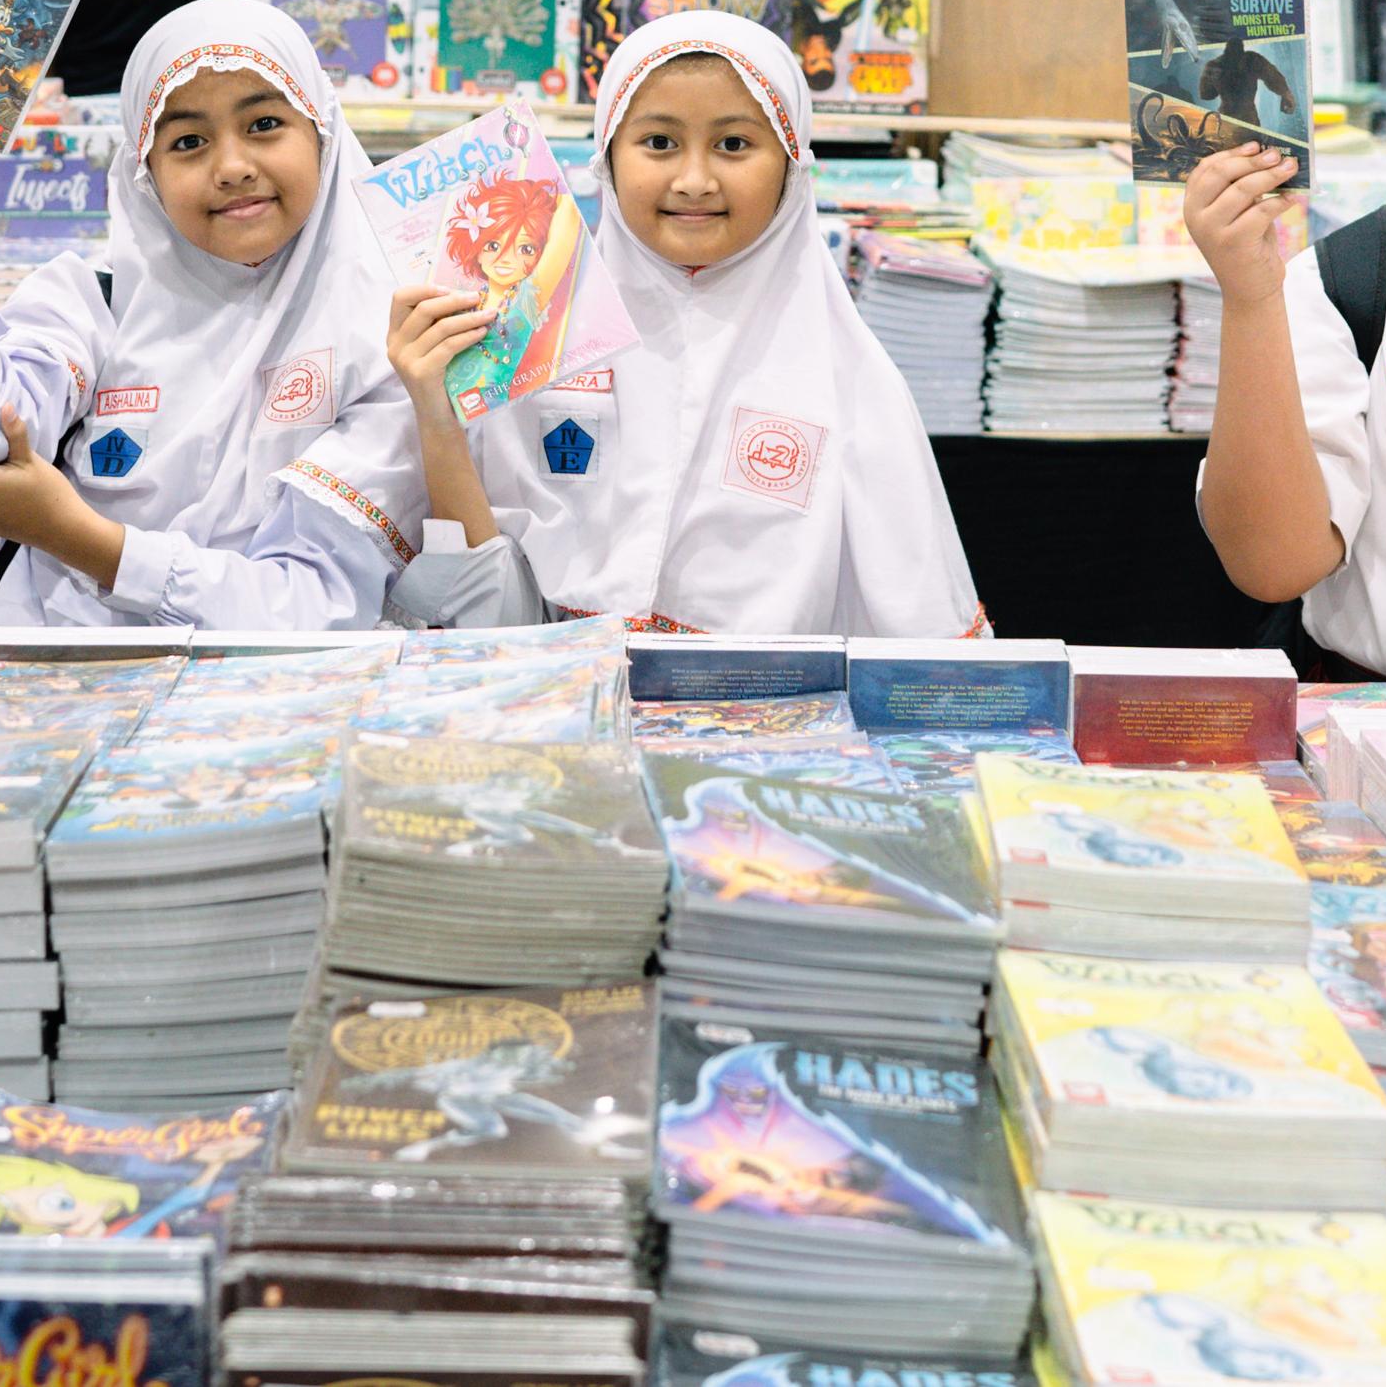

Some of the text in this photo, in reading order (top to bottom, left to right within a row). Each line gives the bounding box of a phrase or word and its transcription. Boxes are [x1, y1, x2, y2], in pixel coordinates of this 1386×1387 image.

[1232, 14, 1281, 27] MONSTER
[1246, 24, 1296, 37] HUNTING?
[5, 163, 91, 211] Insects
[485, 380, 510, 399] THE
[104, 393, 151, 409] AISHALINA
[102, 456, 124, 474] D
[558, 451, 580, 471] E
[793, 1050, 980, 1107] HADES
[316, 1104, 446, 1128] POWER
